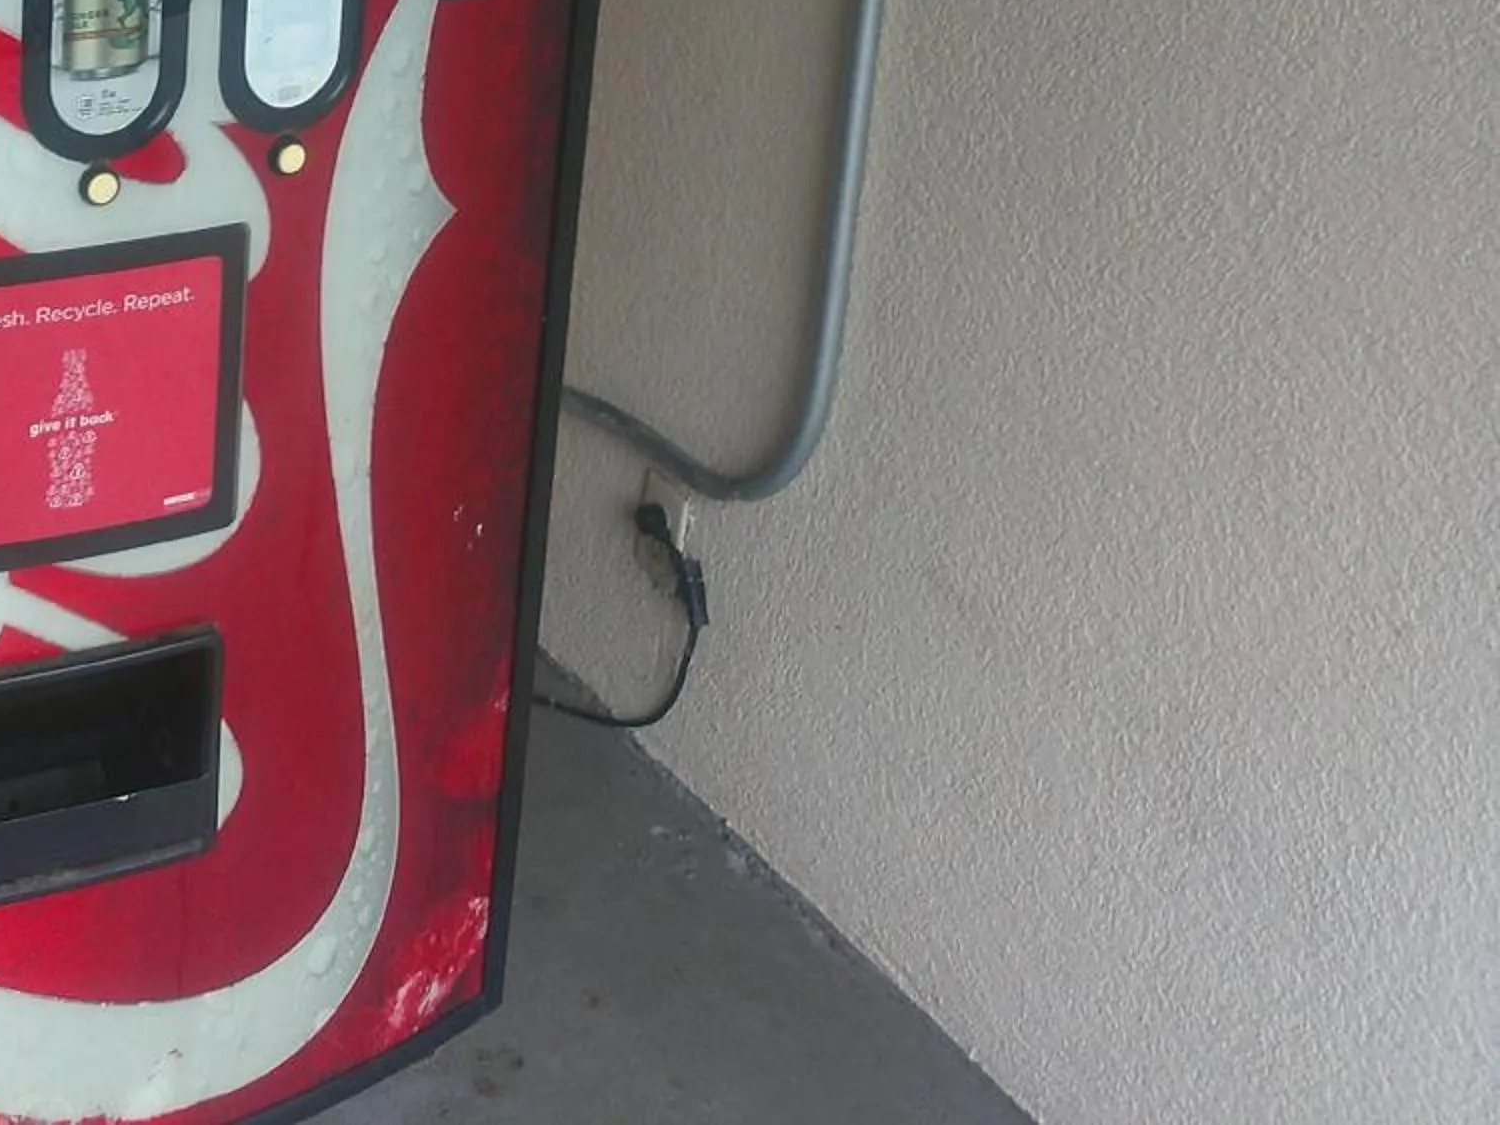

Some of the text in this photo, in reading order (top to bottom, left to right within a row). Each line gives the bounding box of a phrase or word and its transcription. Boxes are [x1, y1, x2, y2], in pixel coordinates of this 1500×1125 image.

[35, 299, 118, 324] Recycle.
[123, 286, 195, 312] Repeat.
[29, 410, 115, 438] give it back
